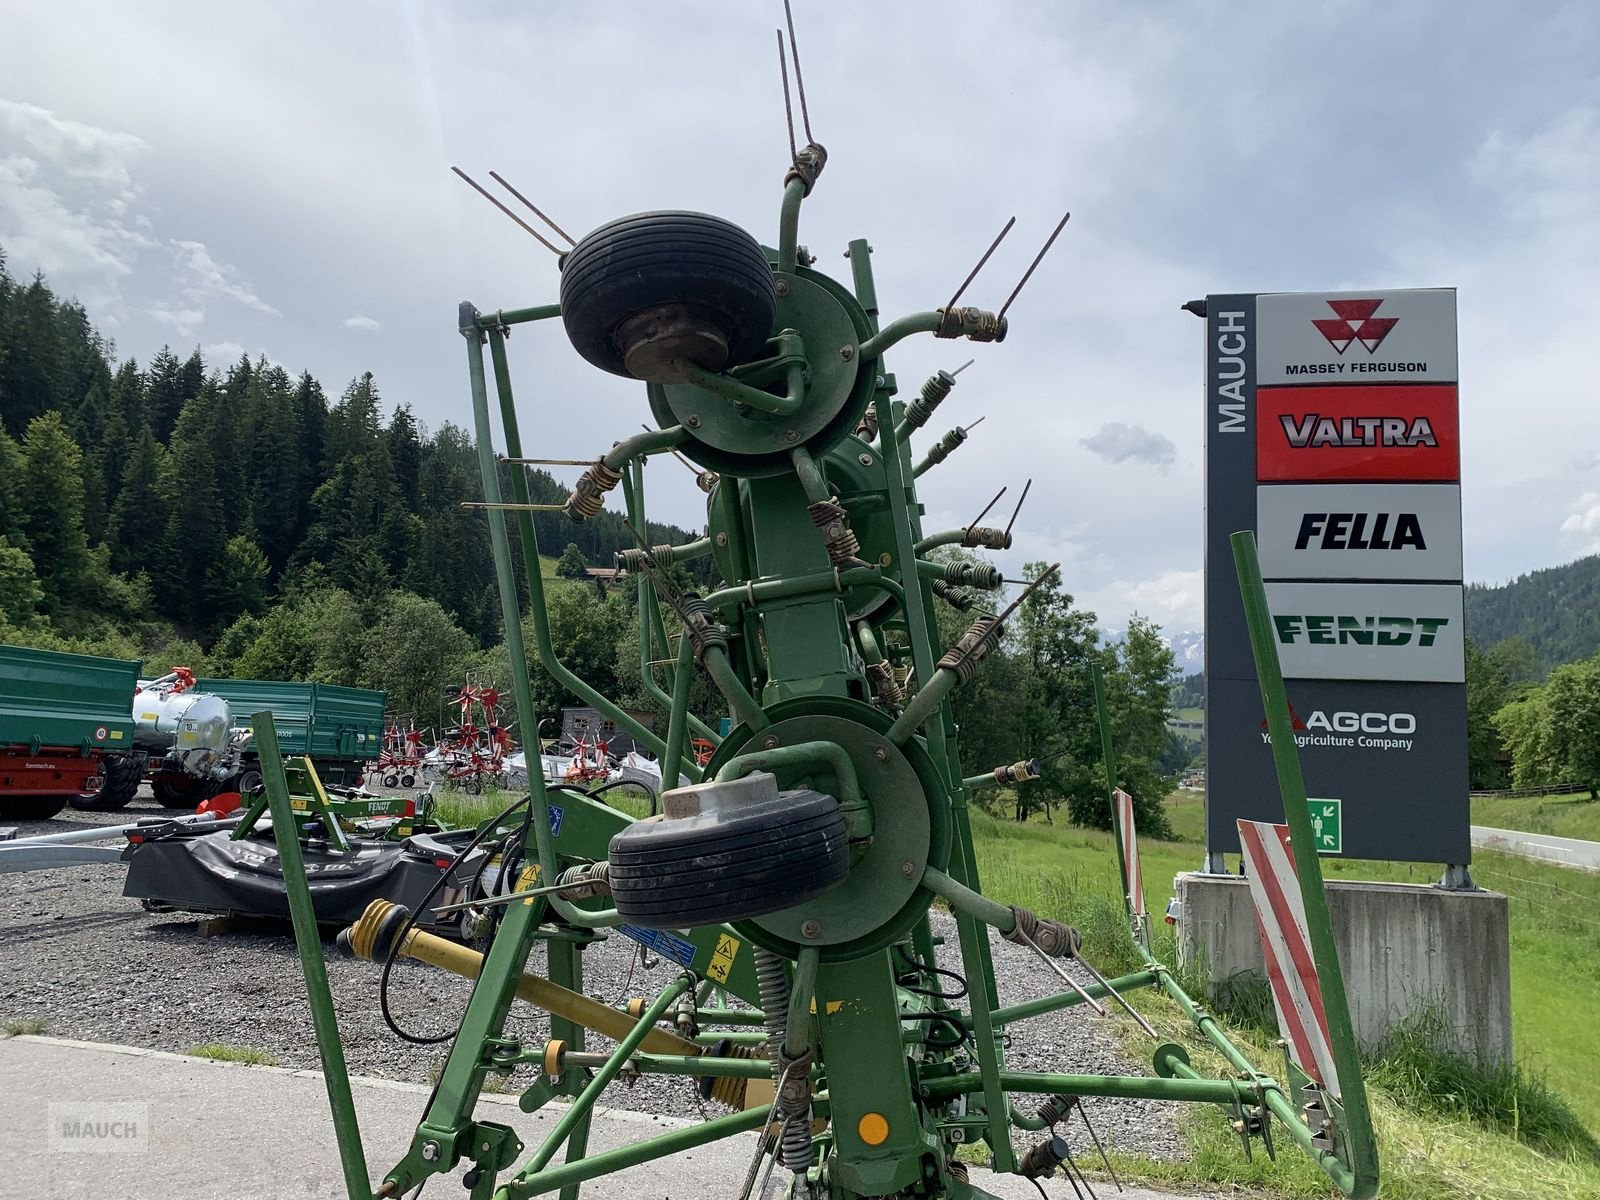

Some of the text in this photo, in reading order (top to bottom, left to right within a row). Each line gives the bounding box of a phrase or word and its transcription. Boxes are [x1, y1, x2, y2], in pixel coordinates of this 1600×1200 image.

[1218, 310, 1246, 433] MAUCH
[1286, 362, 1427, 375] MASSEY FERGUSON
[1278, 413, 1438, 448] VALTRA
[1294, 513, 1427, 550] FELLA
[1273, 615, 1449, 647] FENDT
[1306, 711, 1416, 734] AGCO
[1358, 736, 1413, 751] Company
[368, 801, 391, 811] FENDT
